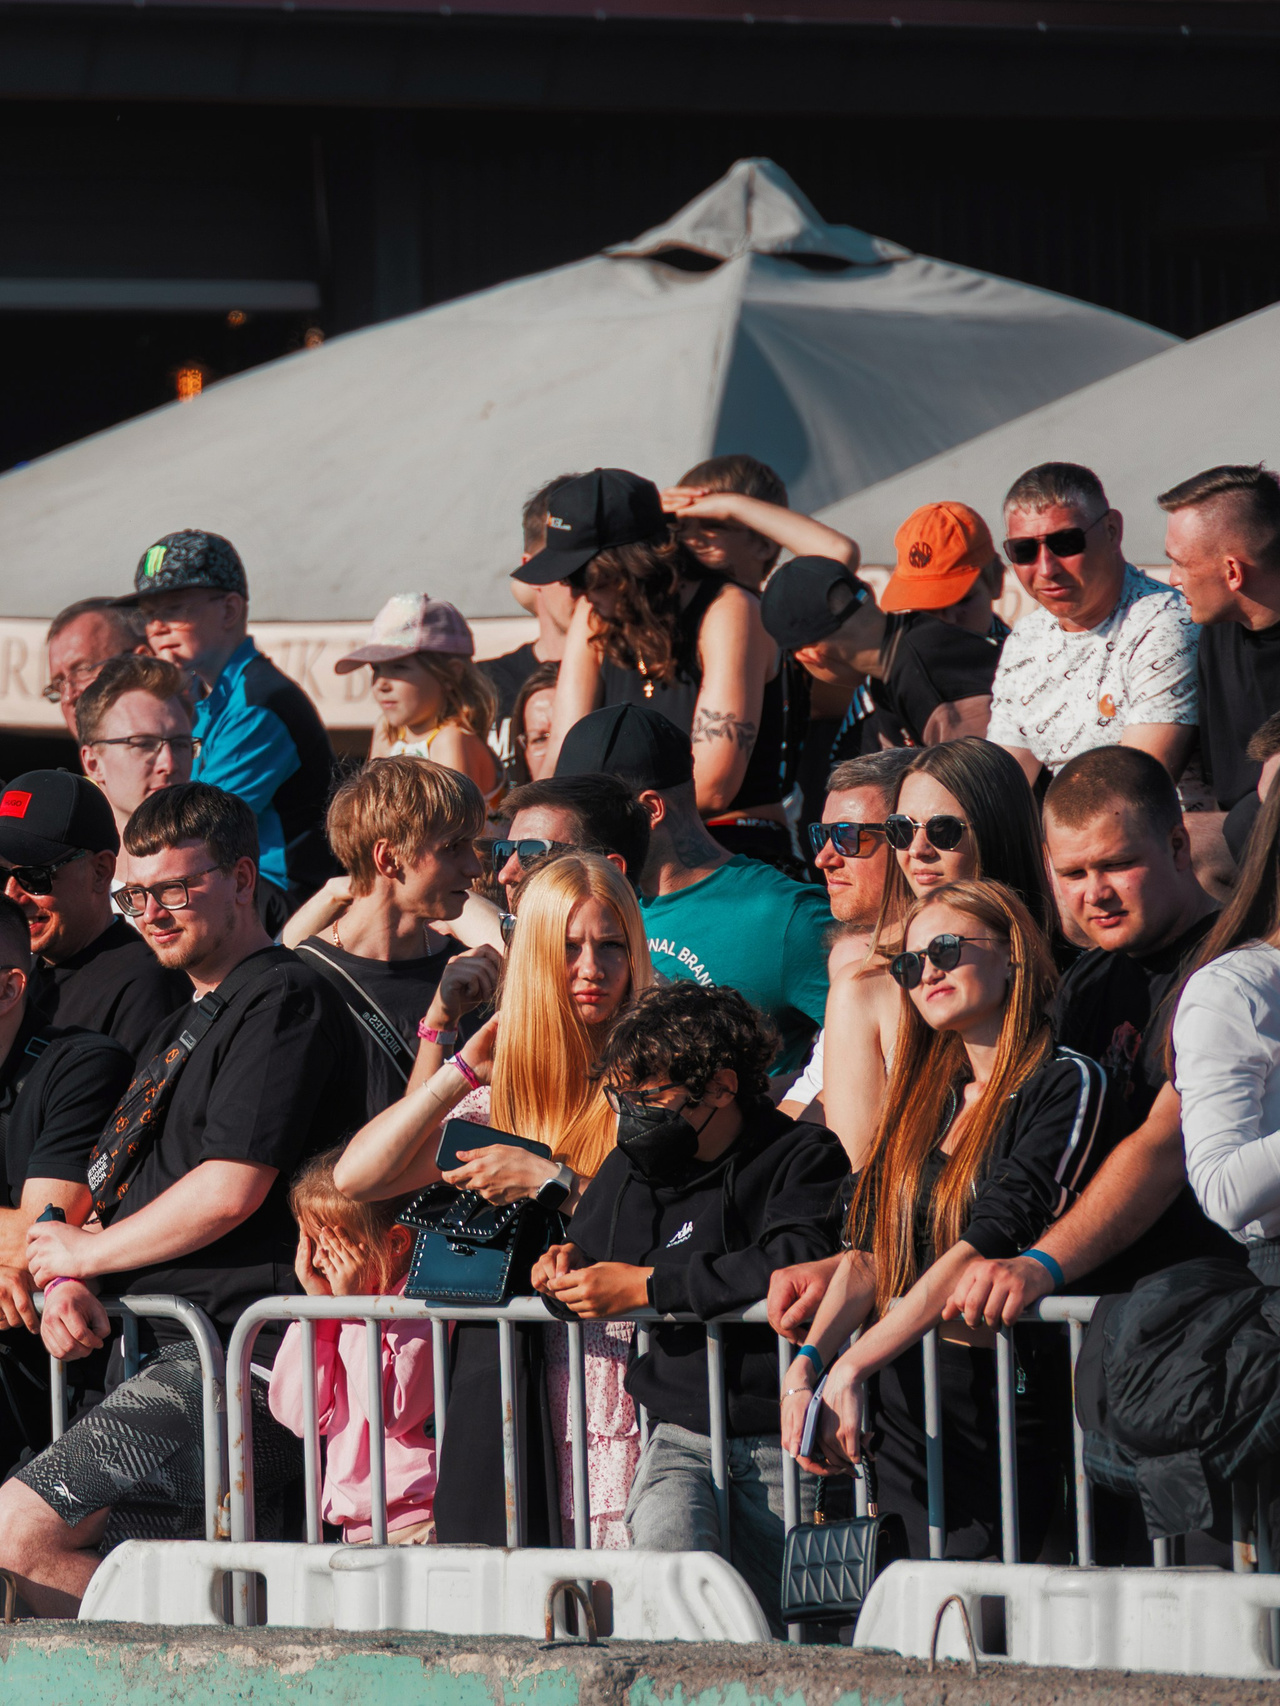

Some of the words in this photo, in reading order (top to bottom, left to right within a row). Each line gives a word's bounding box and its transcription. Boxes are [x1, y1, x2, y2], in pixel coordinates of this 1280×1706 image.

[647, 938, 676, 957] NAL
[677, 946, 714, 987] BRAN
[90, 1171, 107, 1191] SOON
